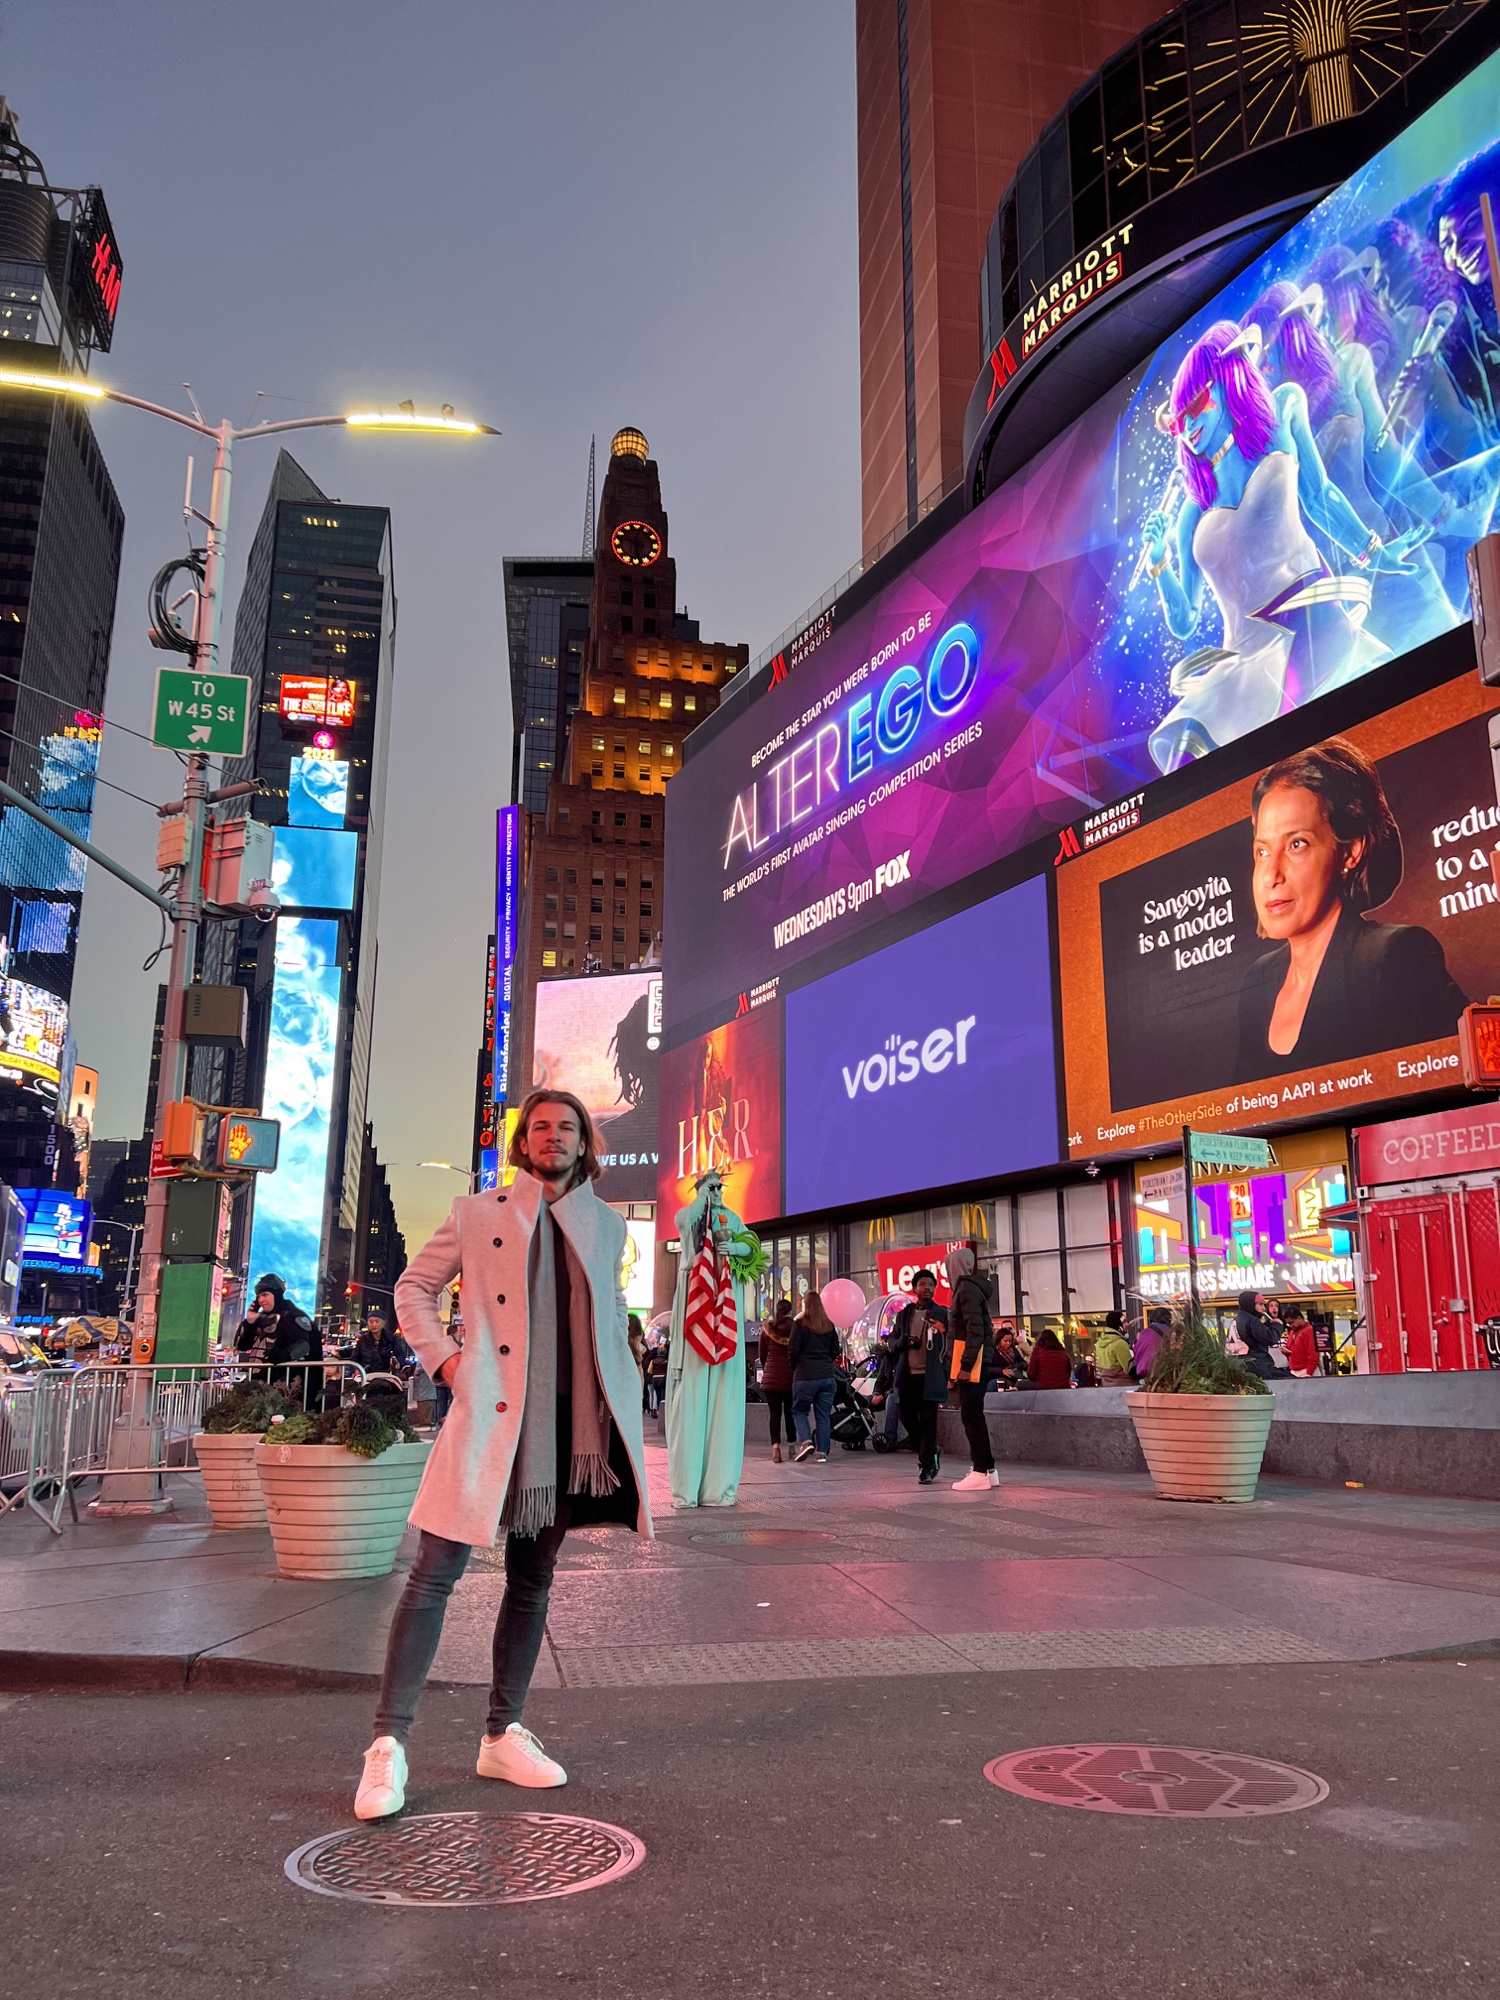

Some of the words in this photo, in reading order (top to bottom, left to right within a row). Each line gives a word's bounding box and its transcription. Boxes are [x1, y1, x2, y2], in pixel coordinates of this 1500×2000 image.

[92, 233, 121, 317] H&M
[1024, 223, 1133, 330] MARRIOTT
[1025, 260, 1119, 353] MARQUIS
[791, 605, 836, 653] MARRIOTT
[791, 626, 831, 669] MARQUIS
[191, 680, 215, 698] TO
[751, 734, 785, 768] BECOME
[785, 721, 800, 740] THE
[801, 701, 821, 727] STAR
[823, 689, 841, 709] YOU
[844, 663, 868, 693] WERE
[871, 638, 899, 671] BORN
[901, 626, 915, 646] TO
[918, 611, 932, 633] BE
[168, 700, 184, 717] W
[185, 703, 212, 719] 45
[216, 705, 235, 722] St
[303, 746, 335, 760] 2021
[722, 723, 841, 870] ALTER
[848, 622, 979, 783] EGO
[722, 883, 736, 902] THE
[737, 862, 770, 894] WORLD'S
[771, 848, 791, 869] FIRST
[792, 826, 824, 857] AVATAR
[825, 799, 866, 835] SINGING
[868, 748, 941, 807] COMPETITION
[944, 721, 983, 758] SERIES
[1084, 792, 1145, 831] MARRIOTT
[1085, 812, 1138, 846] MARQUIS
[1432, 806, 1500, 848] redu
[1435, 857, 1462, 881] to
[1469, 848, 1489, 871] a
[773, 887, 846, 949] WEDNESDAYS
[847, 878, 873, 912] 9pm
[875, 849, 912, 895] FOX
[1144, 876, 1232, 924] Sangoyita
[1139, 933, 1155, 955] is
[1158, 930, 1171, 947] a
[1173, 899, 1234, 942] model
[1174, 934, 1236, 971] leader
[750, 976, 780, 998] MARRIOTT
[750, 989, 777, 1008] MARQUIS
[500, 1011, 511, 1092] Bitdefender
[842, 1015, 976, 1099] voiser
[1097, 1123, 1136, 1142] Explore
[1138, 1102, 1223, 1131] #TheOtherSide
[1226, 1097, 1239, 1114] of
[1242, 1092, 1278, 1111] being
[1282, 1081, 1315, 1102] AAPI
[1320, 1080, 1334, 1094] at
[1337, 1069, 1373, 1090] work
[1397, 1054, 1459, 1078] Explore
[44, 1124, 57, 1166] 1500
[619, 1153, 637, 1166] US
[639, 1153, 649, 1165] A
[1200, 1137, 1233, 1149] PEDESTRIAN
[1234, 1140, 1249, 1150] FLOW
[1250, 1141, 1265, 1152] ZONE
[1229, 1150, 1243, 1160] KEEP
[1244, 1152, 1265, 1163] MOVING
[1142, 1176, 1166, 1188] PEDESTRIAN
[1160, 1273, 1176, 1294] AT
[1177, 1269, 1217, 1293] TIES
[1218, 1265, 1275, 1291] SQUARE
[1294, 1257, 1354, 1286] INVICTA
